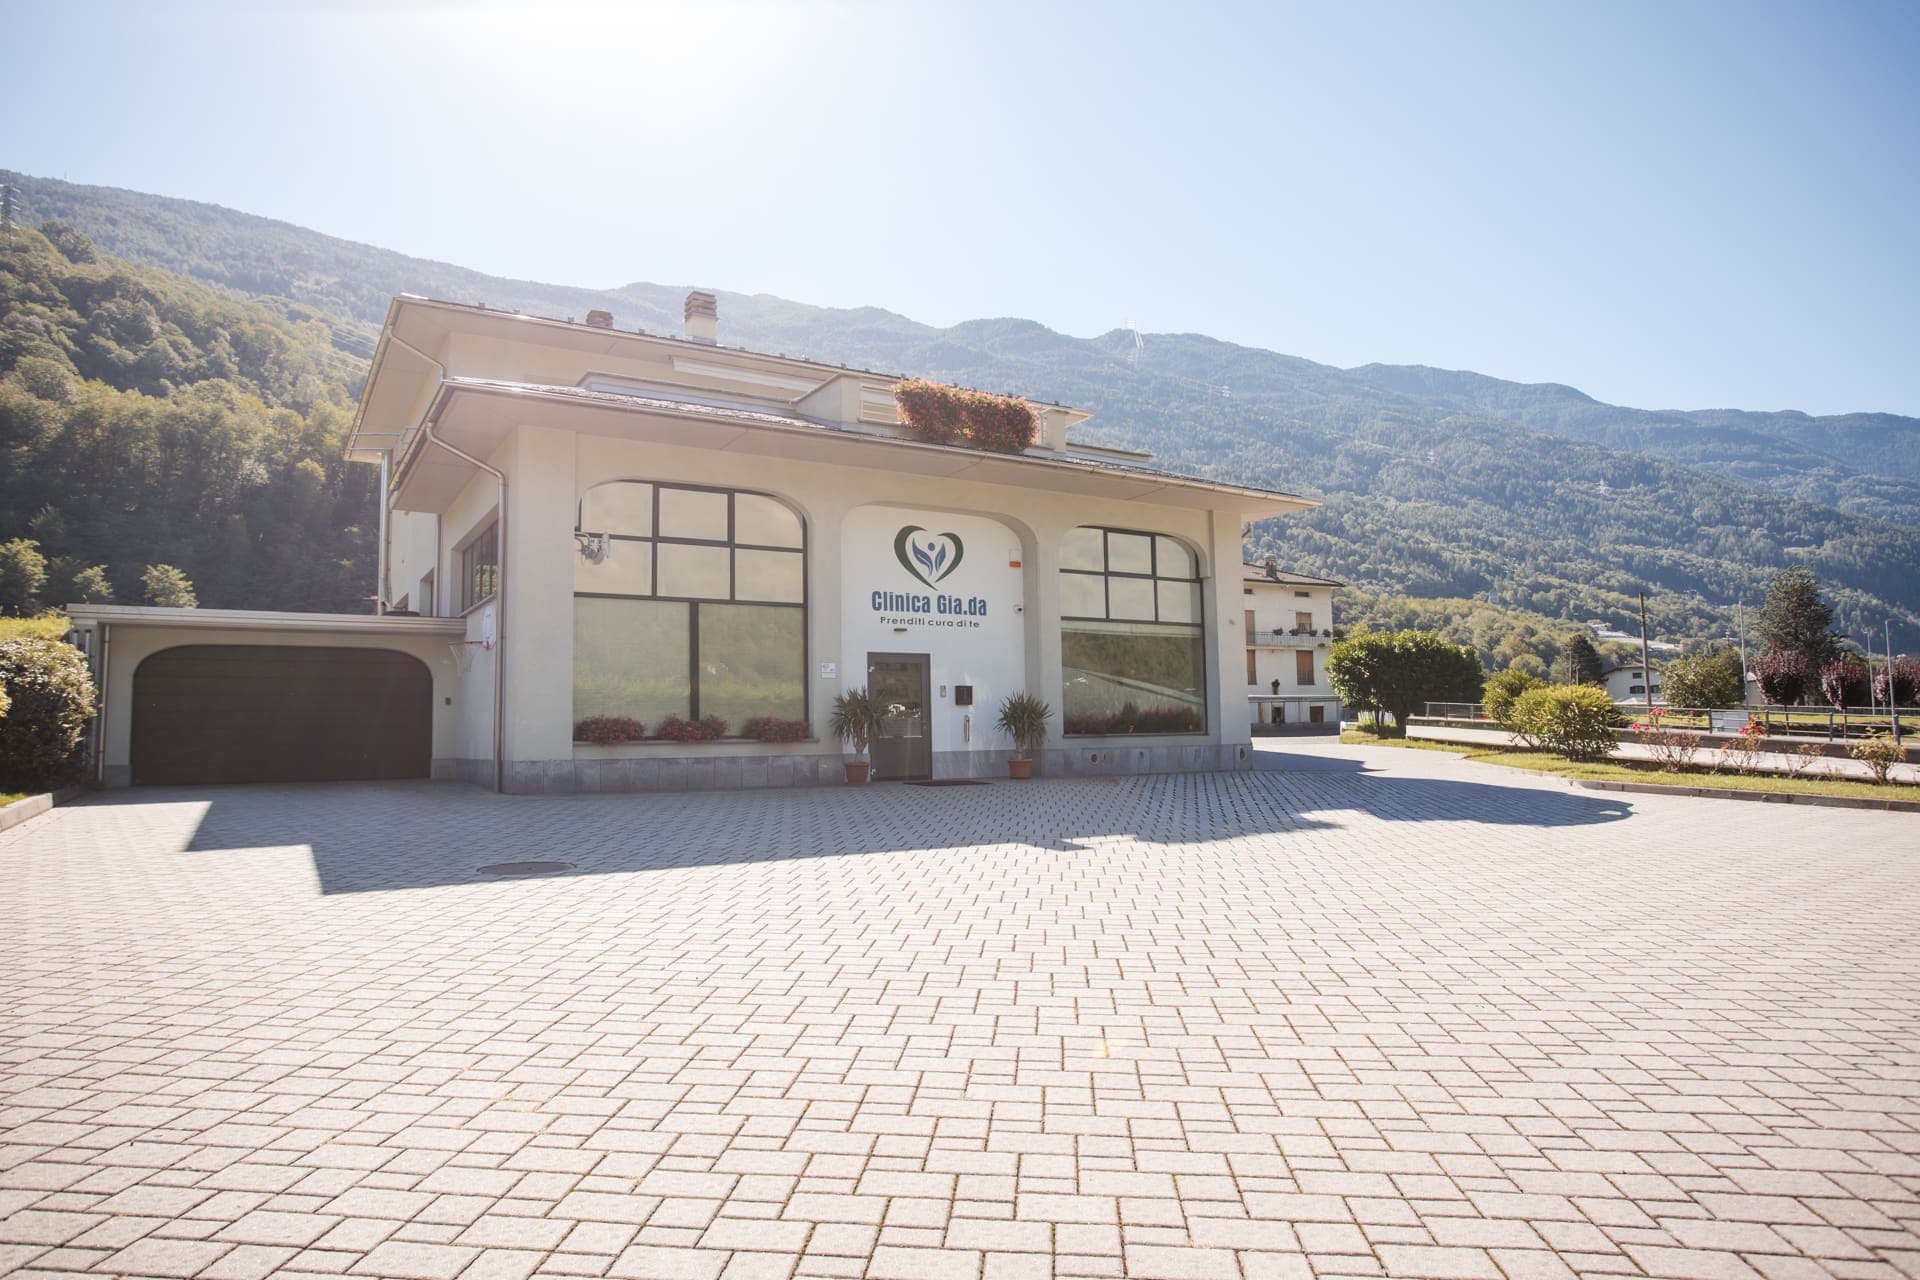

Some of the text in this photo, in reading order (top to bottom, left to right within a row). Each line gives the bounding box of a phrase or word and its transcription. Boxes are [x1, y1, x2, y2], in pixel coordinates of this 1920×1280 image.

[871, 590, 987, 616] Clinica Gia.da
[880, 616, 980, 628] Prenditi cura di te
